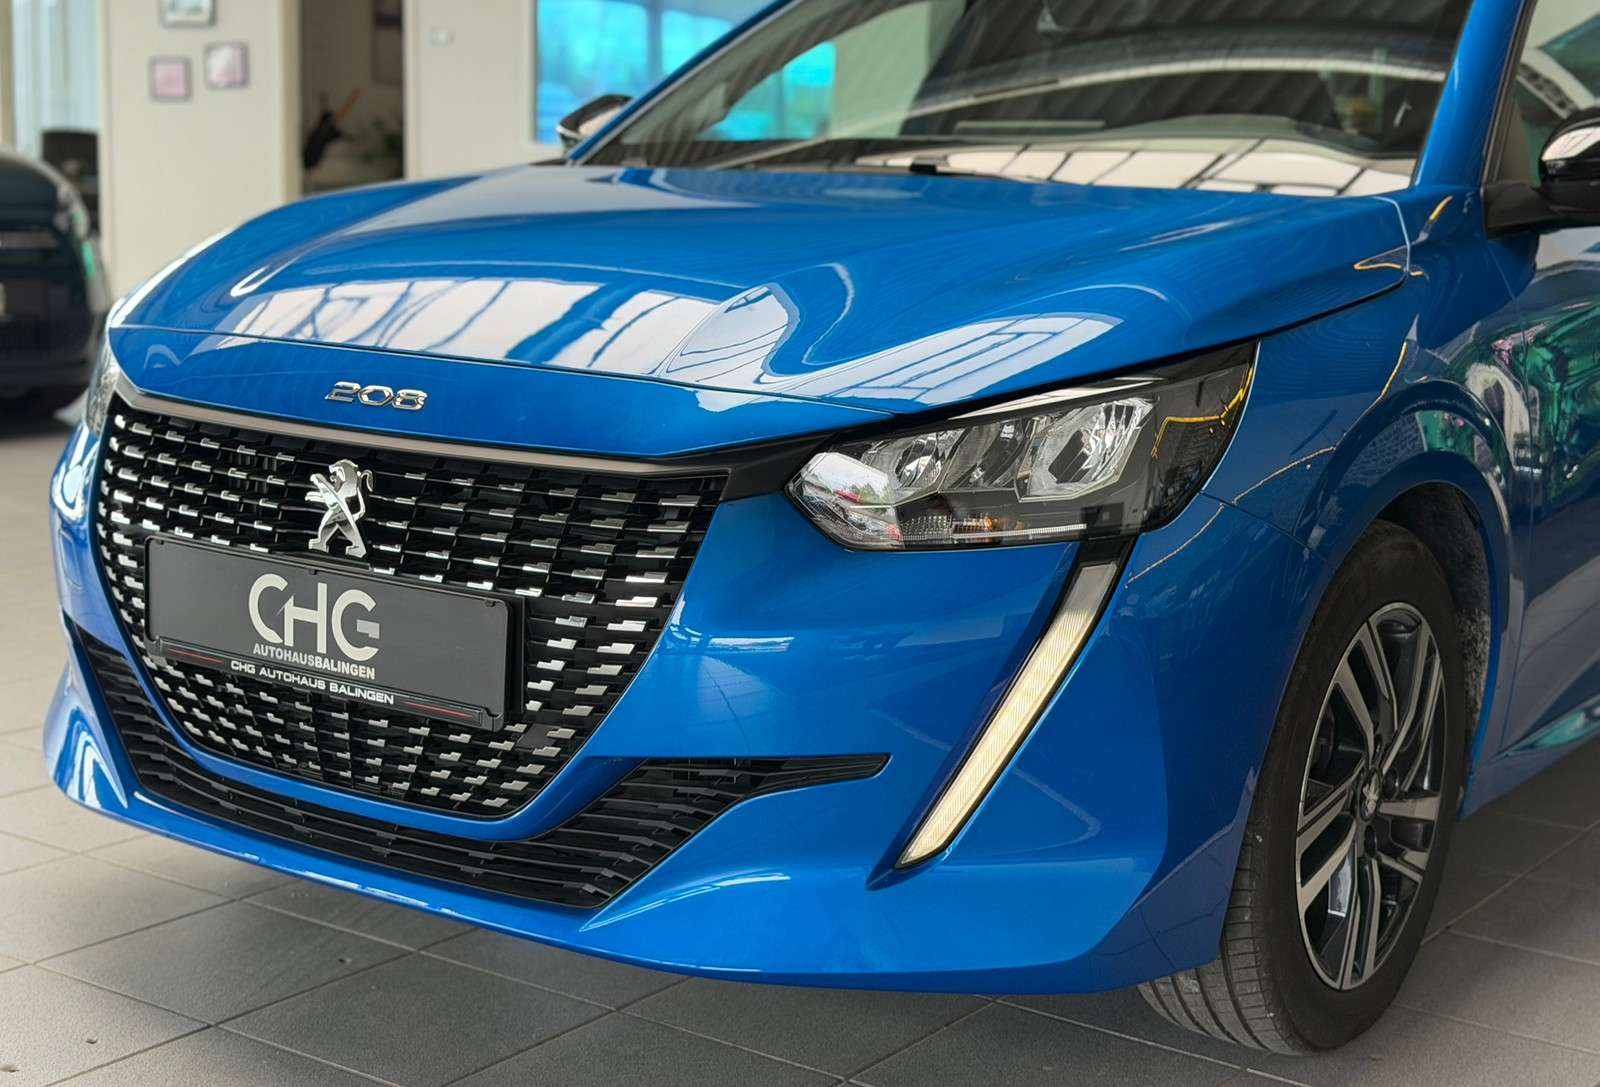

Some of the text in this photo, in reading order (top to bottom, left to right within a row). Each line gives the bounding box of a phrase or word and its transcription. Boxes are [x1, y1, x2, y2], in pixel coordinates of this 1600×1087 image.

[324, 381, 428, 411] 208
[248, 573, 380, 661] CHG
[230, 660, 394, 705] CHG AUTOHAUS BALINGEN
